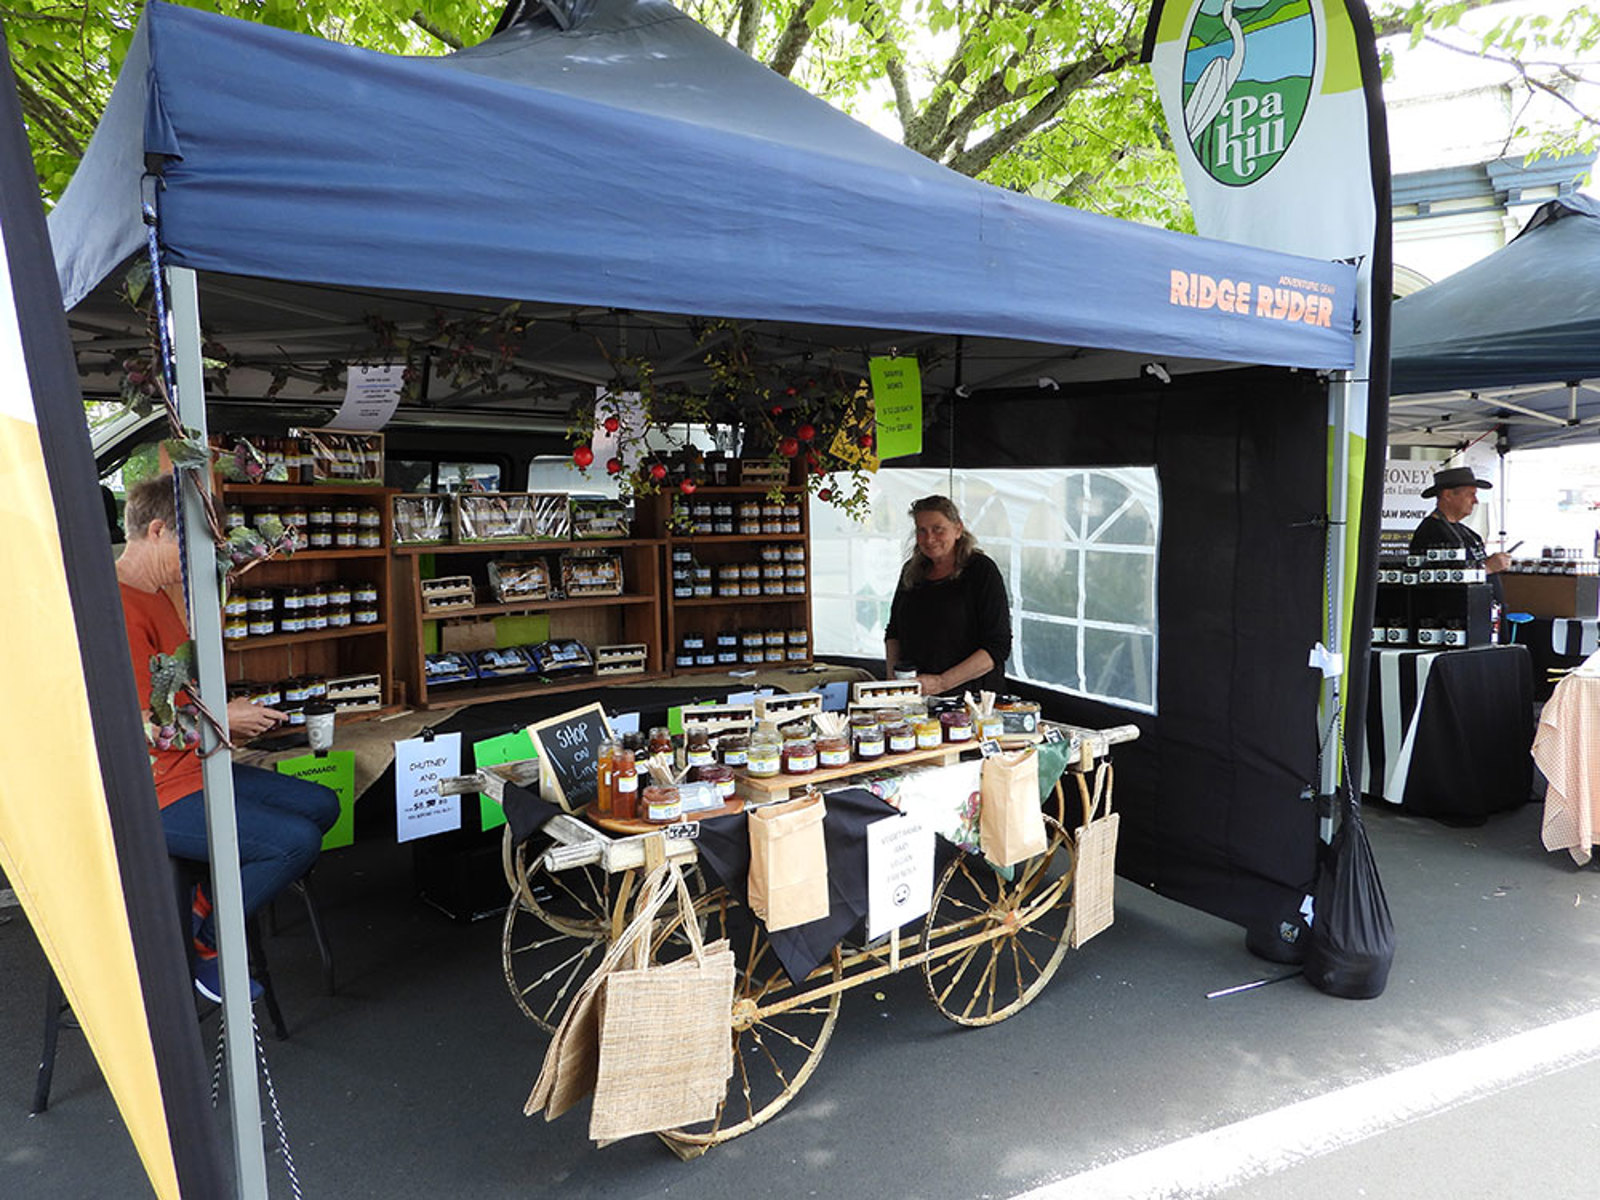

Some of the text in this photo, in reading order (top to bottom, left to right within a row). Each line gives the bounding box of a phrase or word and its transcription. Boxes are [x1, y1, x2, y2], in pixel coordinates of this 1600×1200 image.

[1220, 92, 1283, 138] Pa
[1216, 118, 1285, 177] hill
[1170, 270, 1333, 328] RIDGE RYDER
[556, 722, 589, 748] SHOP
[409, 757, 448, 772] CHUTNEY
[420, 772, 438, 782] AND
